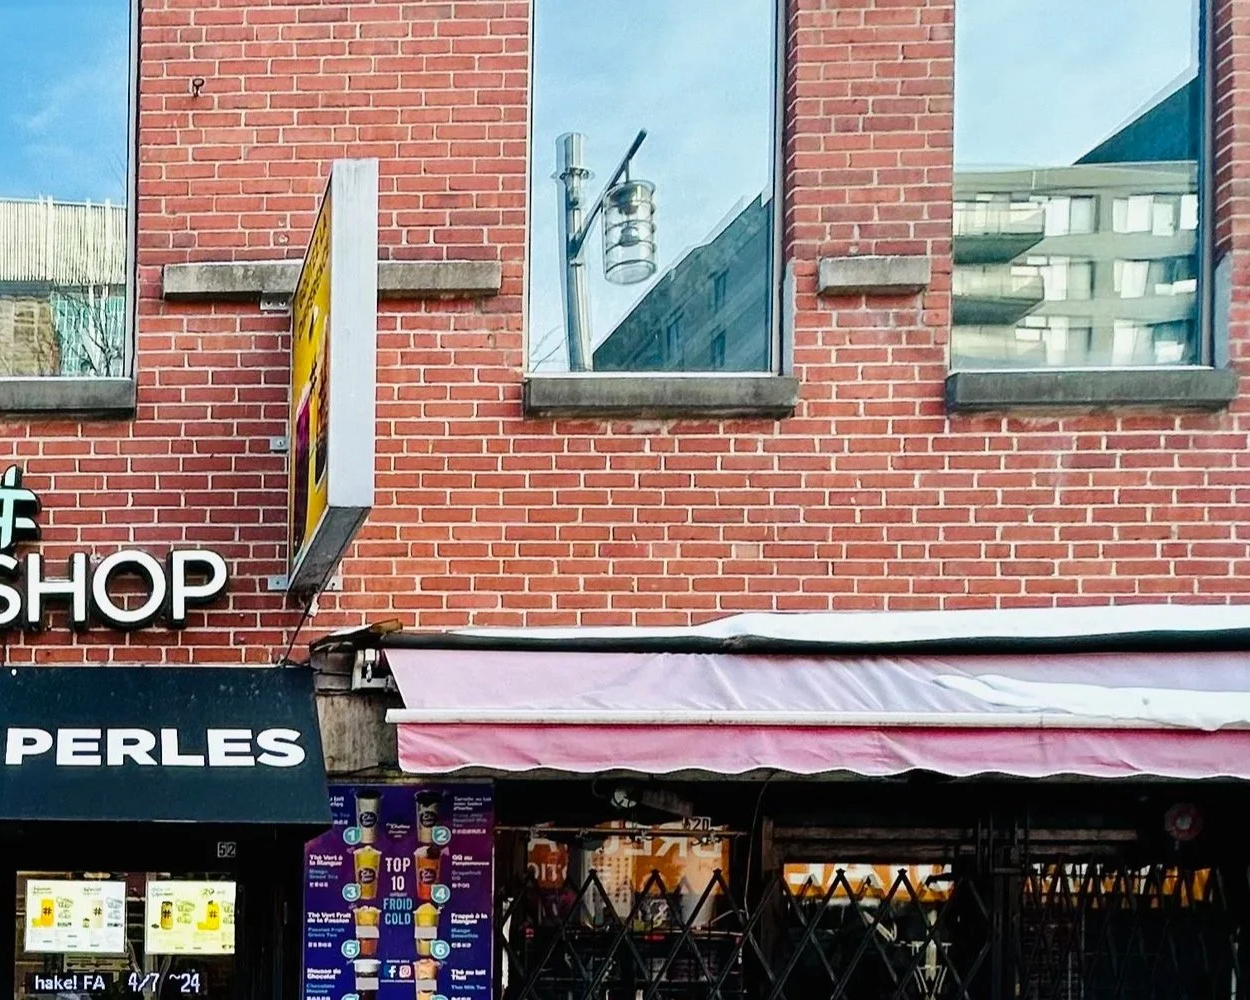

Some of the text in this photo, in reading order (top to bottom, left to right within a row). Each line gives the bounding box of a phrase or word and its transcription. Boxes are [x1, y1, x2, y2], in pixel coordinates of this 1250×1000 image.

[4, 726, 307, 768] PERLES
[347, 829, 356, 841] 1
[436, 829, 447, 841] 2
[218, 842, 236, 858] 52
[385, 857, 411, 872] TOP
[391, 876, 405, 891] 10
[346, 887, 356, 898] 3
[435, 888, 445, 898] 4
[383, 898, 413, 910] FROID
[384, 913, 411, 925] COLD
[345, 943, 355, 955] 5
[435, 943, 445, 955] 6
[83, 974, 106, 990] FA
[127, 972, 161, 993] 4/7
